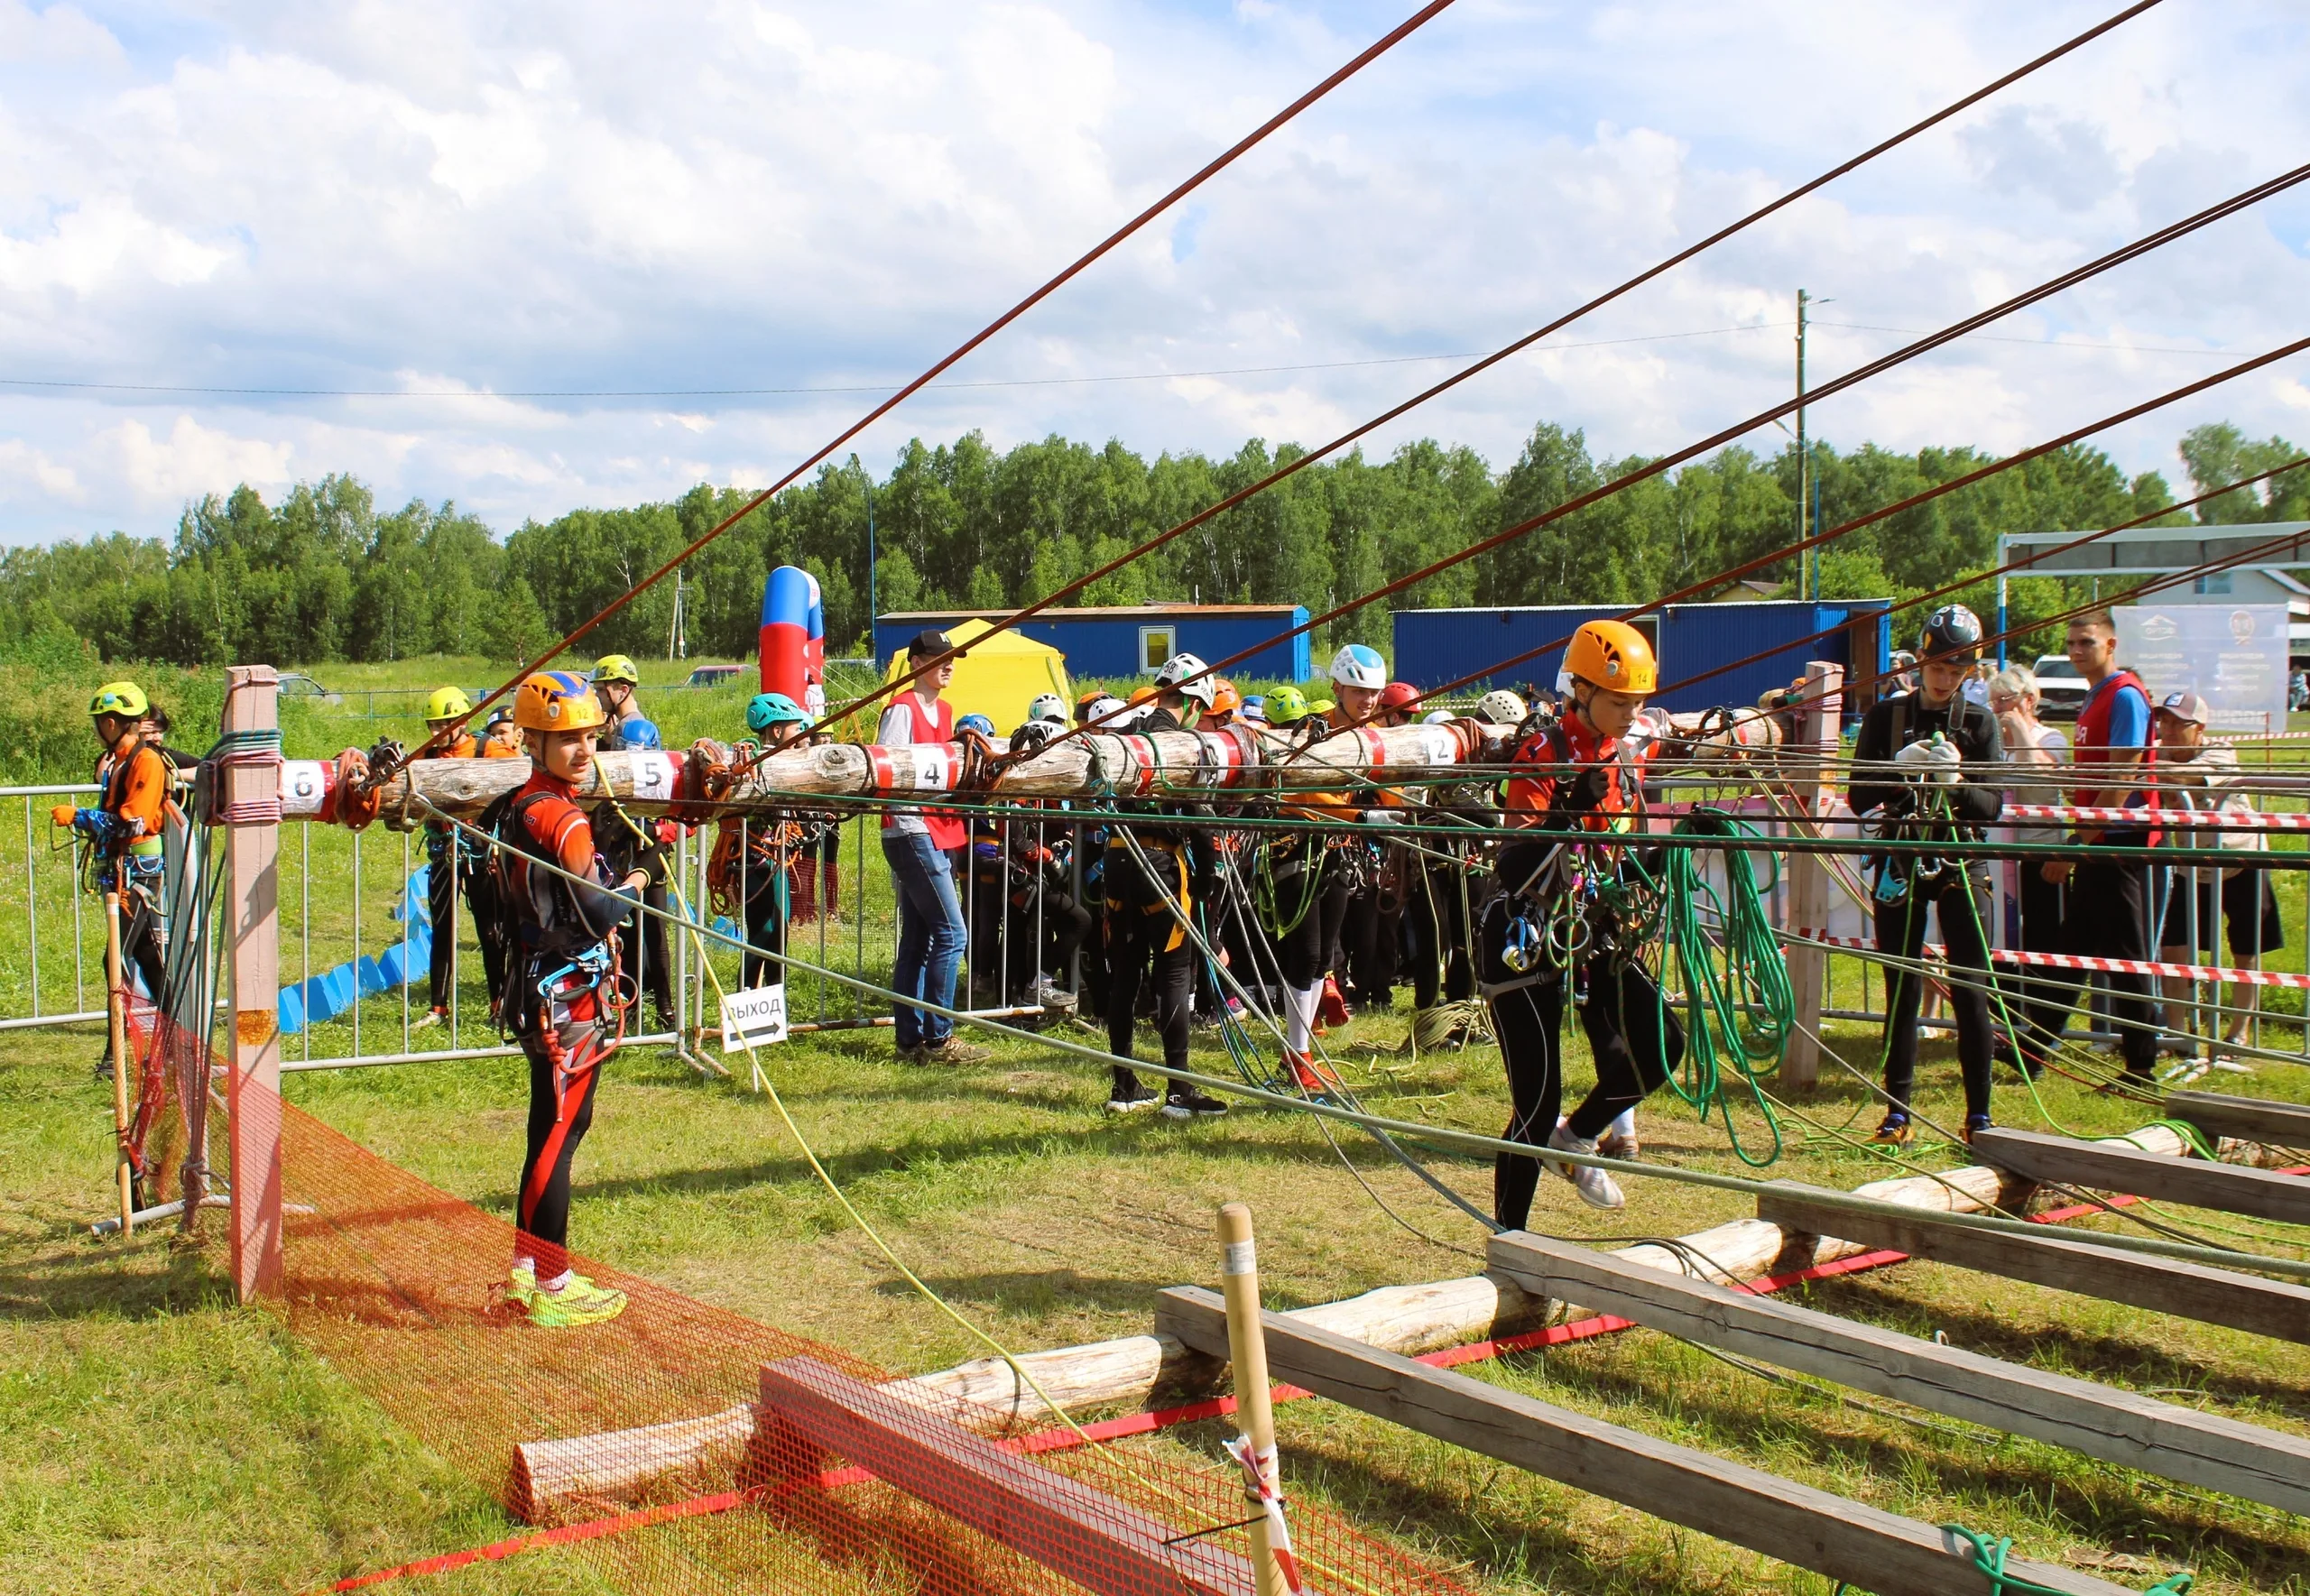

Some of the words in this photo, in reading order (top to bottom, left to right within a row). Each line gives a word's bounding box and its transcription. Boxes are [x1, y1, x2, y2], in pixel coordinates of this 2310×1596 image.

[1637, 673, 1648, 685] 14
[577, 707, 589, 720] 12
[768, 709, 790, 719] VENTO
[1434, 739, 1449, 759] 2
[644, 762, 661, 787] 5
[924, 762, 940, 785] 4
[294, 771, 313, 797] 6
